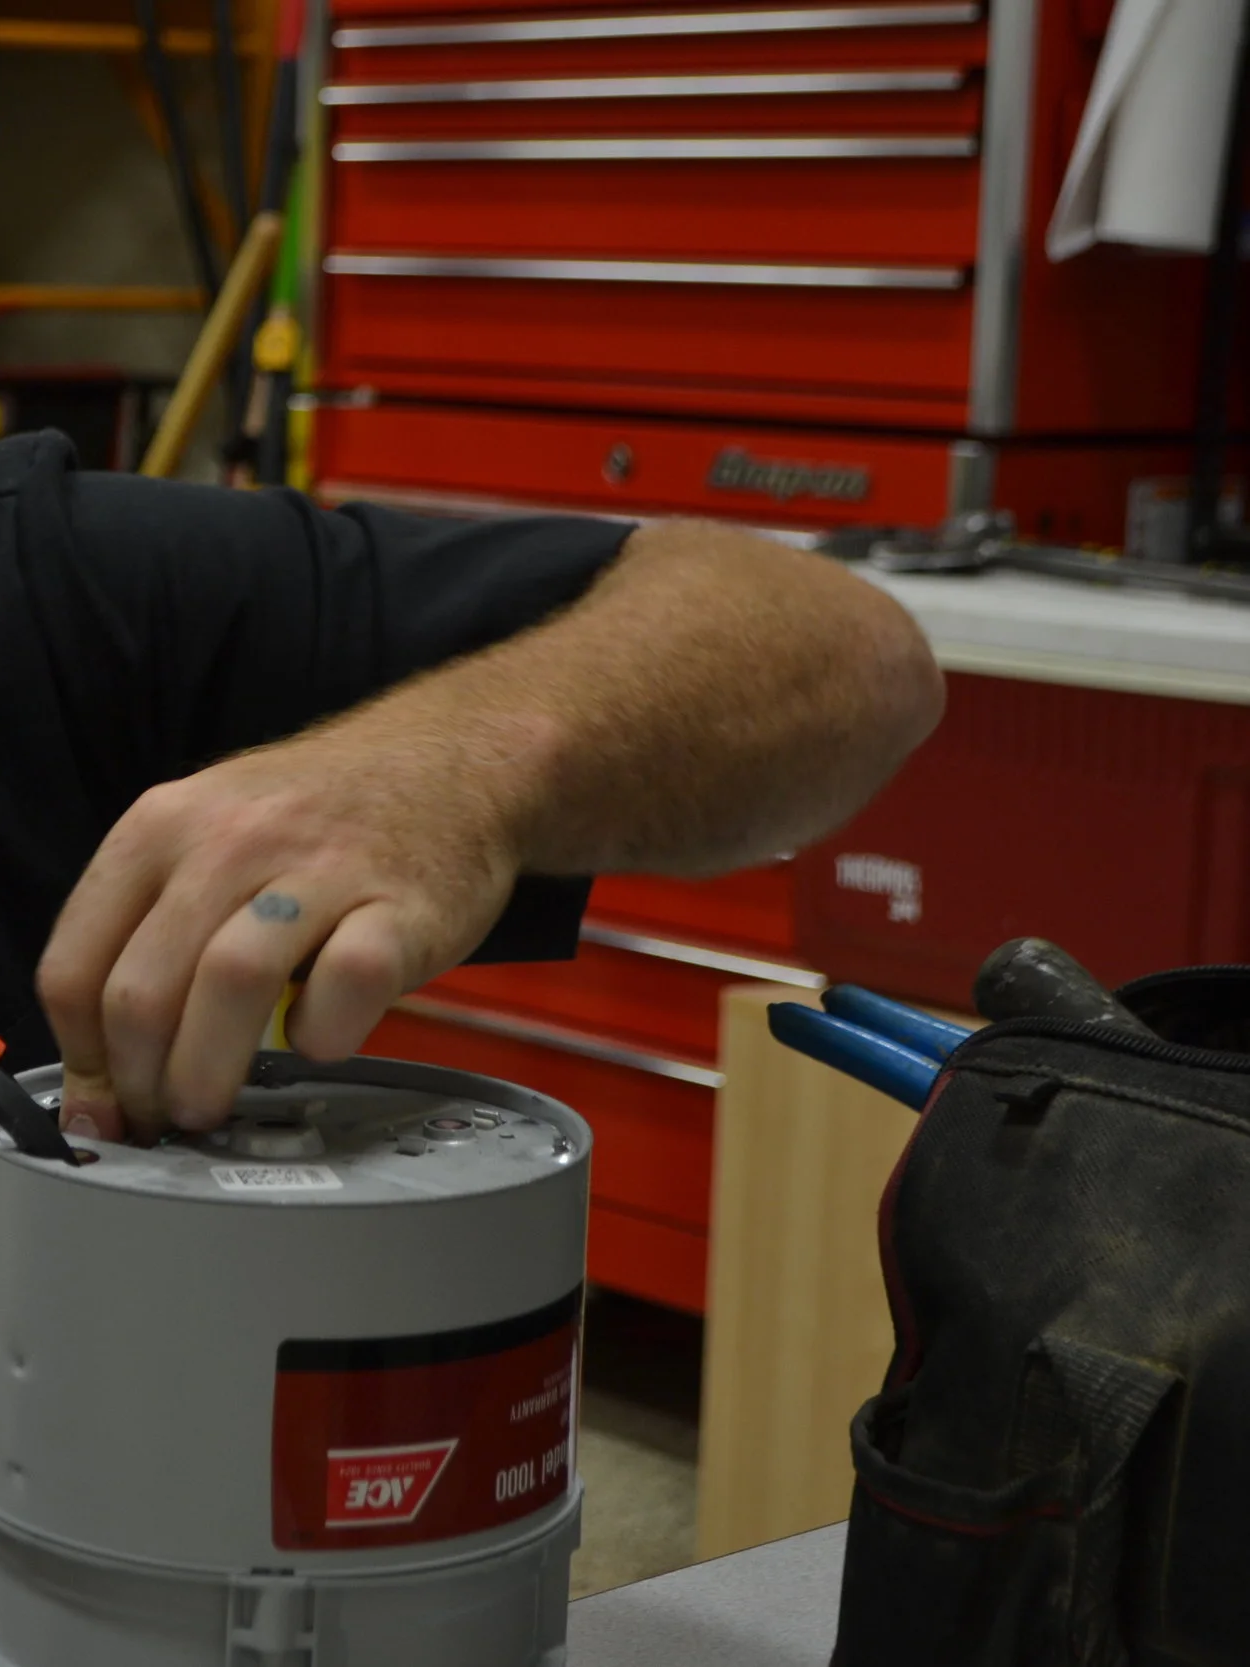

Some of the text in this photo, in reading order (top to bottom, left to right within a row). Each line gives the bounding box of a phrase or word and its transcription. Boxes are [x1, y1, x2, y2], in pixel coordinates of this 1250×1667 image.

[510, 1386, 558, 1423] WARRANTY
[496, 1440, 569, 1502] odel 1000
[344, 1475, 415, 1510] ACE
